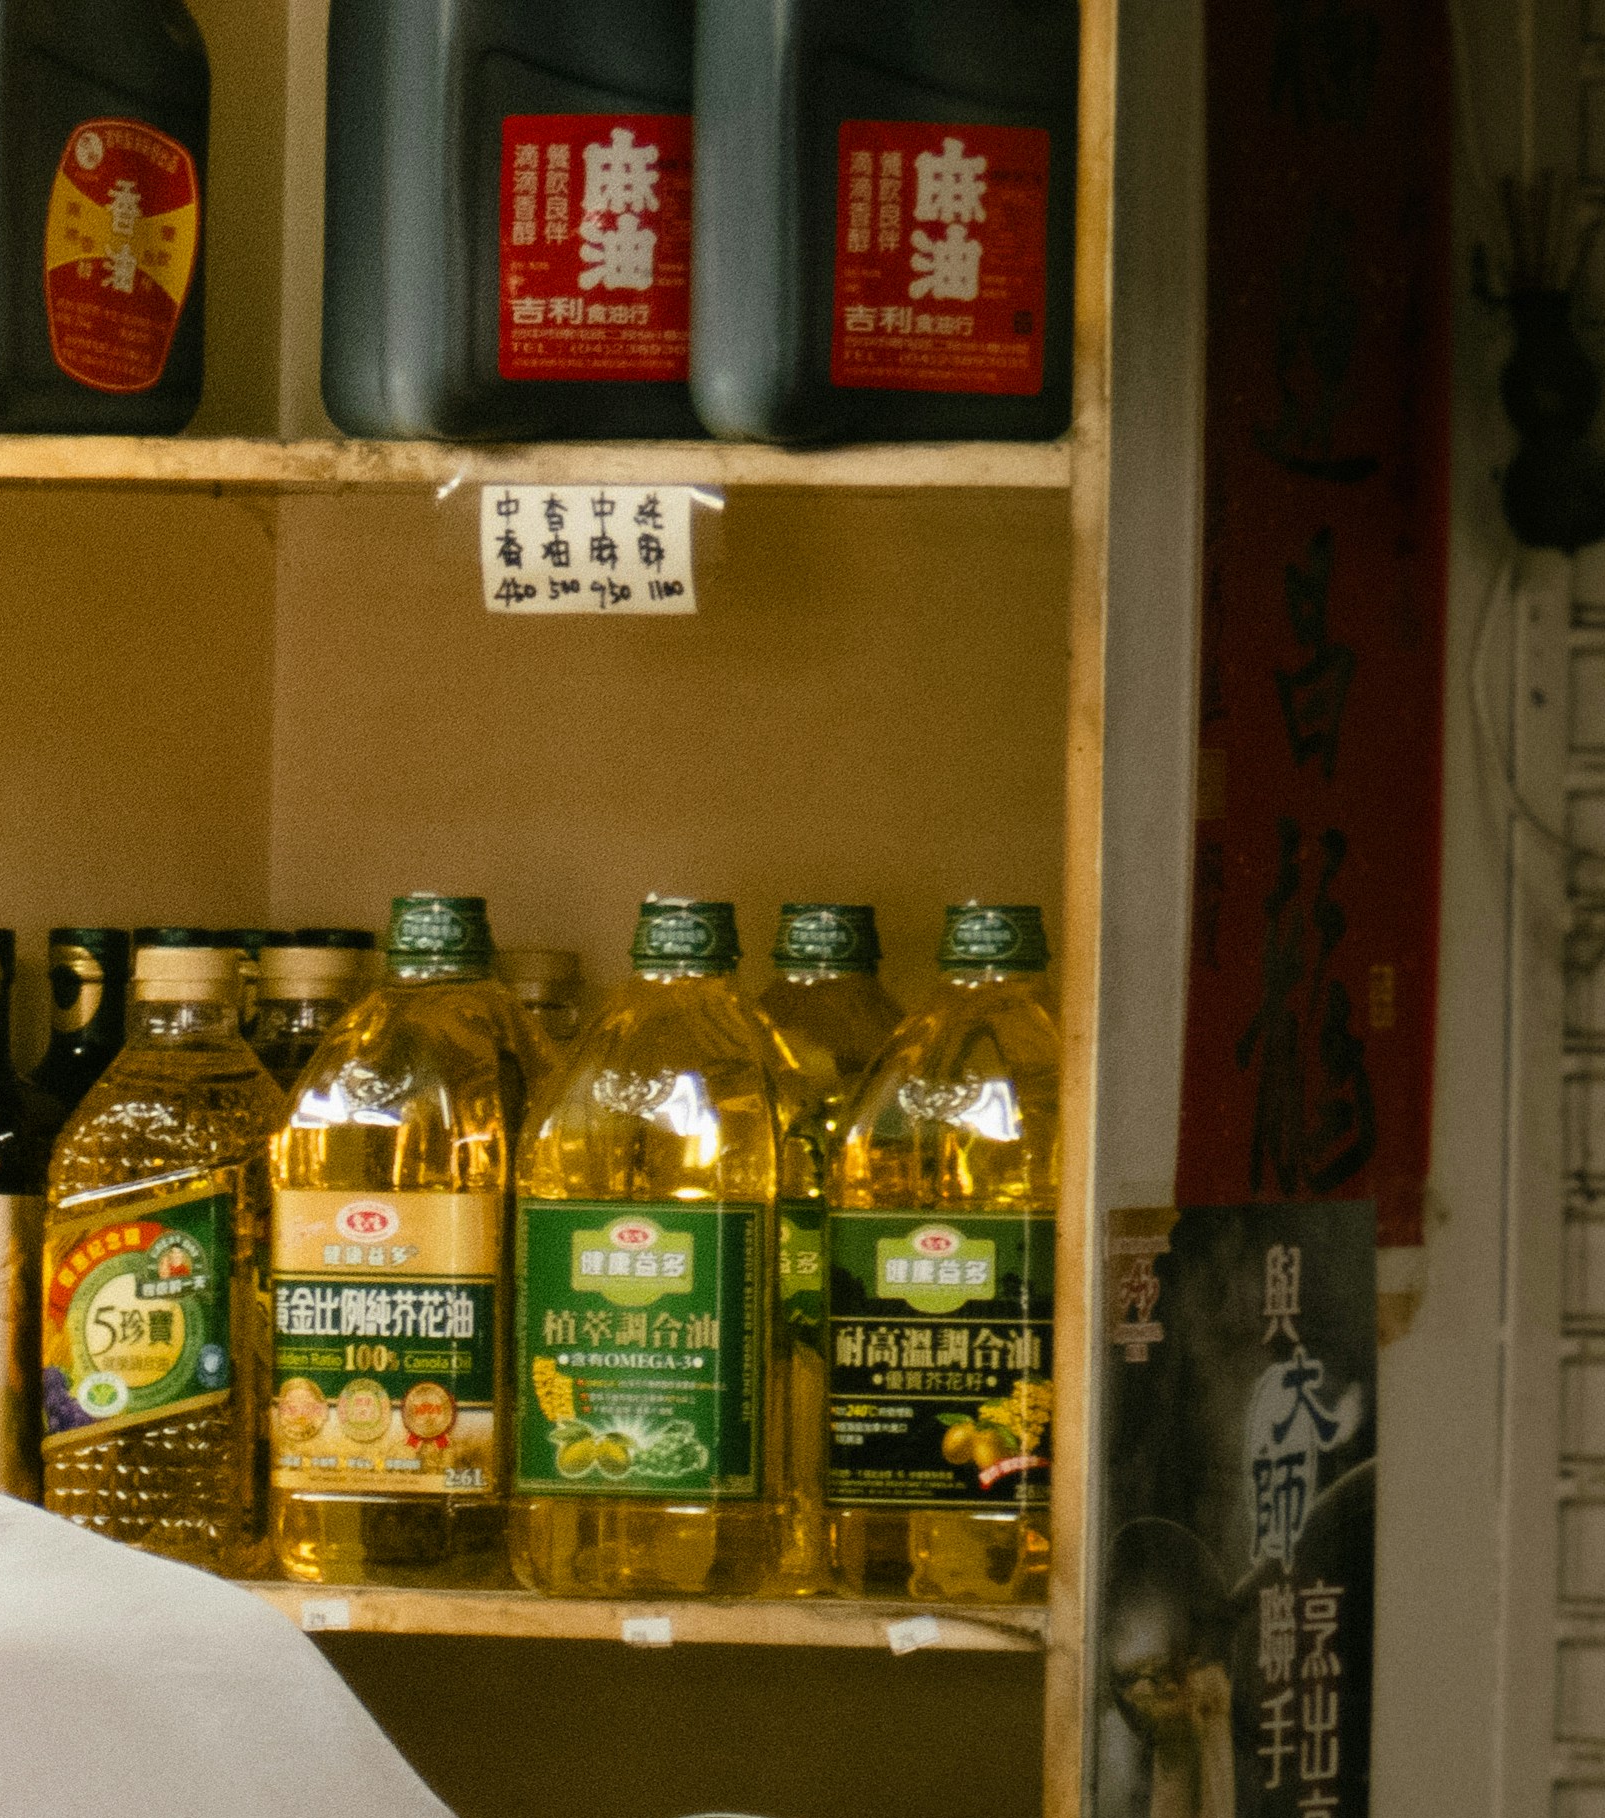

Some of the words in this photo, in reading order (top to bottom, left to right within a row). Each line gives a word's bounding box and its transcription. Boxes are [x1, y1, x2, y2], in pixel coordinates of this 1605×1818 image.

[578, 127, 660, 291] 麻油
[908, 136, 988, 301] 麻油
[835, 1325, 1043, 1370] 耐高溫調合油
